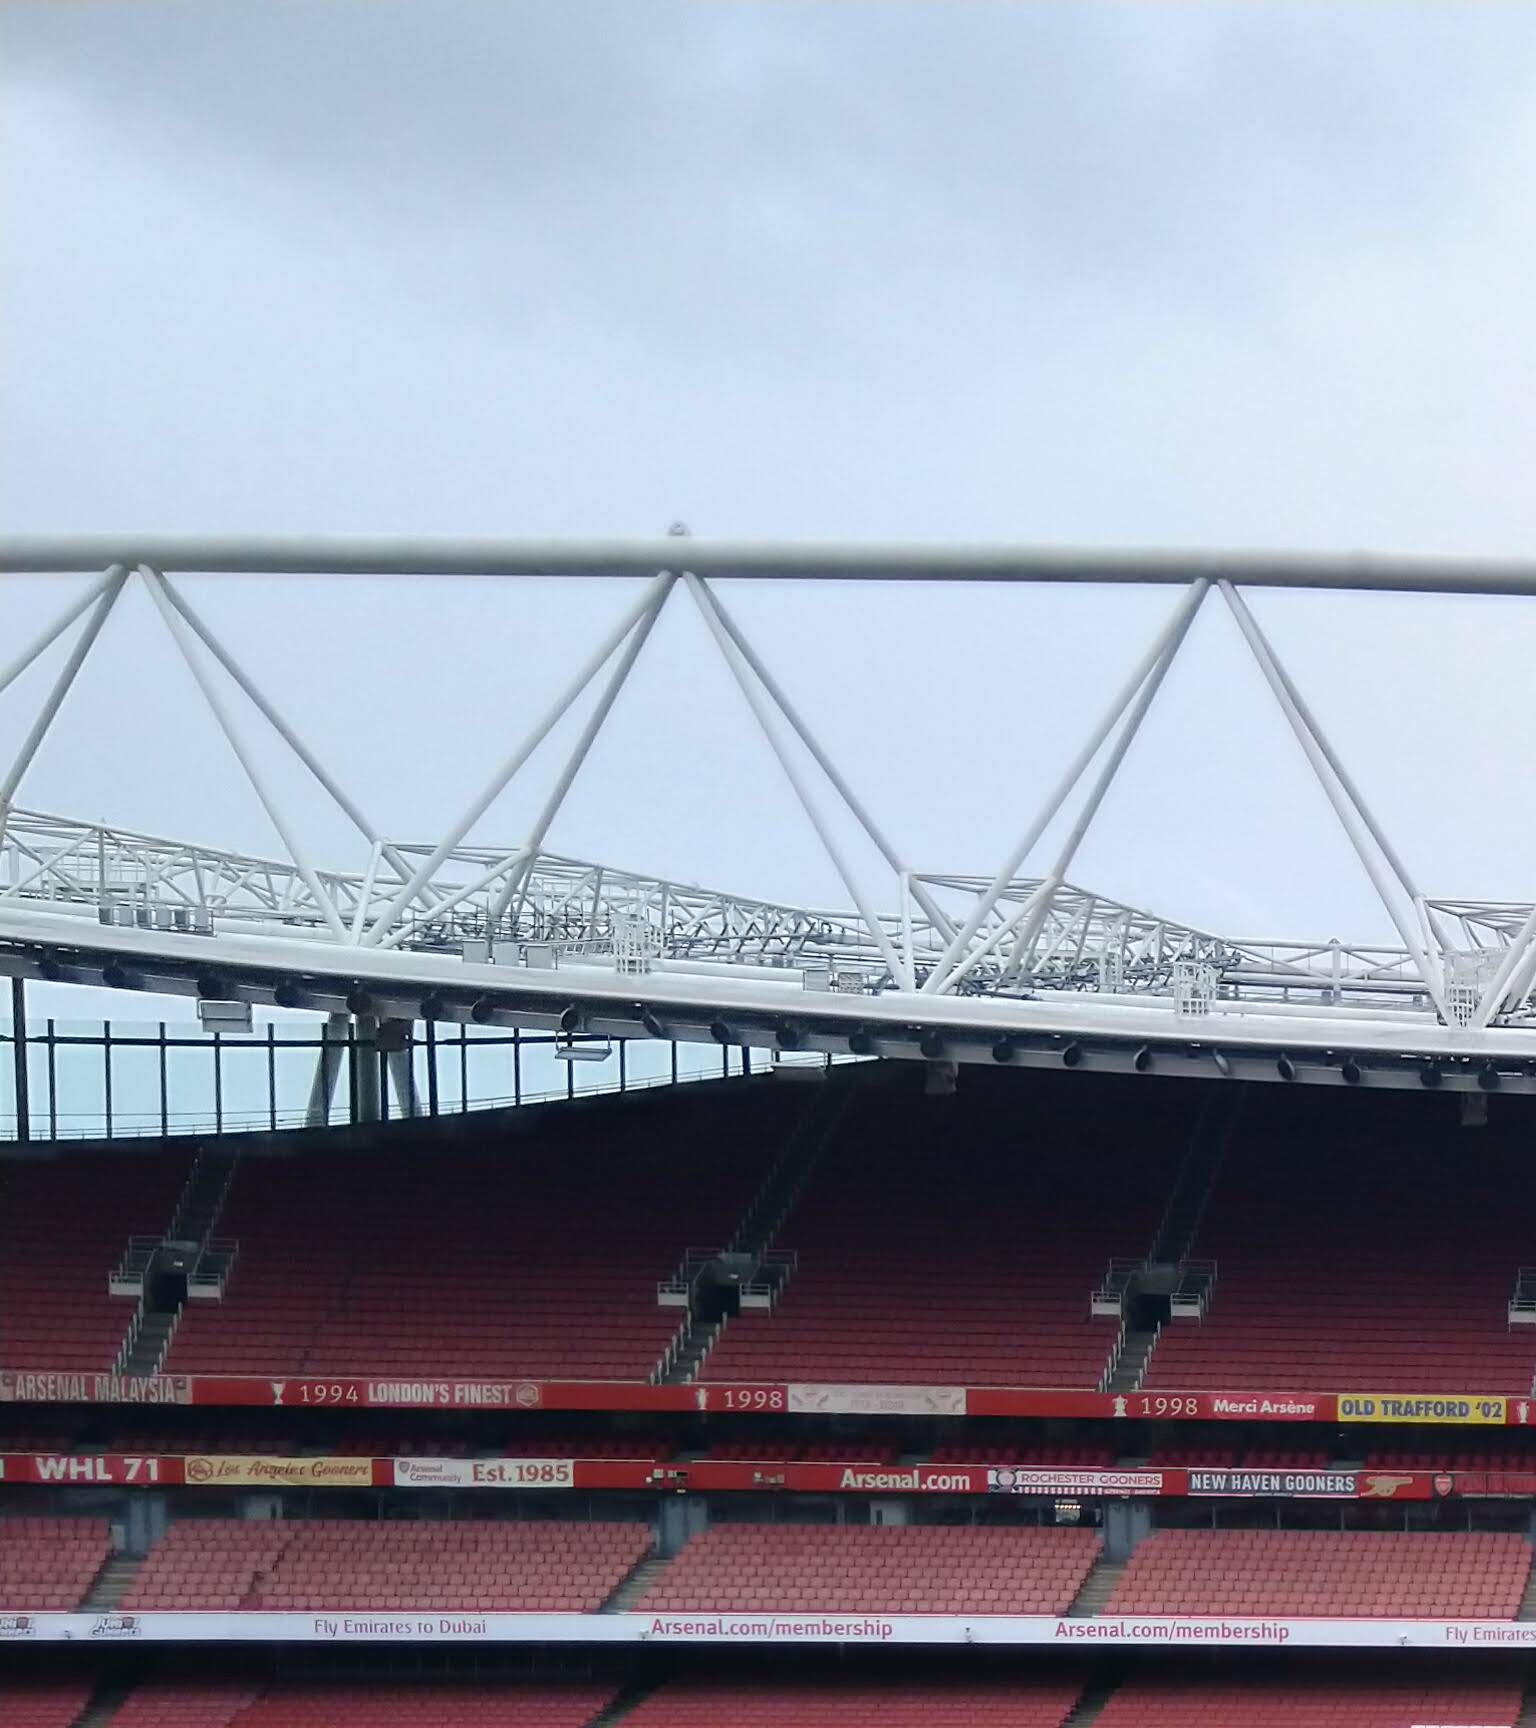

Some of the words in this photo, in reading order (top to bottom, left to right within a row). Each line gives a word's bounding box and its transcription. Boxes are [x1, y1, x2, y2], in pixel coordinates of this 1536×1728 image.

[15, 1375, 88, 1402] ARSENAL
[94, 1377, 176, 1403] MALAYSIA
[300, 1384, 358, 1403] 1994
[368, 1383, 449, 1404] LONDON'S
[455, 1384, 512, 1405] FINEST
[724, 1391, 783, 1408] 1998
[1140, 1398, 1197, 1415] 1998
[1213, 1399, 1257, 1414] Merci
[1260, 1399, 1315, 1414] Arsène
[1341, 1400, 1375, 1416] OLD
[1381, 1401, 1470, 1418] TRAFFORD
[36, 1456, 112, 1480] WHL
[123, 1457, 159, 1480] 71
[216, 1461, 240, 1478] Los
[246, 1461, 305, 1479] Angeles
[311, 1461, 368, 1477] Gooners
[410, 1464, 442, 1473] Arsenal
[472, 1464, 512, 1482] Est.
[516, 1464, 569, 1483] 1985
[410, 1473, 461, 1483] Community
[840, 1469, 970, 1490] Arsenal.com
[1021, 1473, 1094, 1484] ROCHESTER
[1099, 1474, 1161, 1485] GOONERS
[1191, 1474, 1226, 1490] NEW
[1231, 1475, 1280, 1491] HAVEN
[1285, 1475, 1355, 1492] GOONERS
[315, 1619, 337, 1637] Fly
[344, 1619, 411, 1635] Emirates
[417, 1621, 433, 1635] to
[439, 1619, 486, 1635] Dubai
[652, 1618, 892, 1640] Arsenal.com/membership
[1055, 1621, 1289, 1643] Arsenal.com/membership
[1446, 1626, 1468, 1644] Fly
[1473, 1626, 1536, 1641] Emirates
